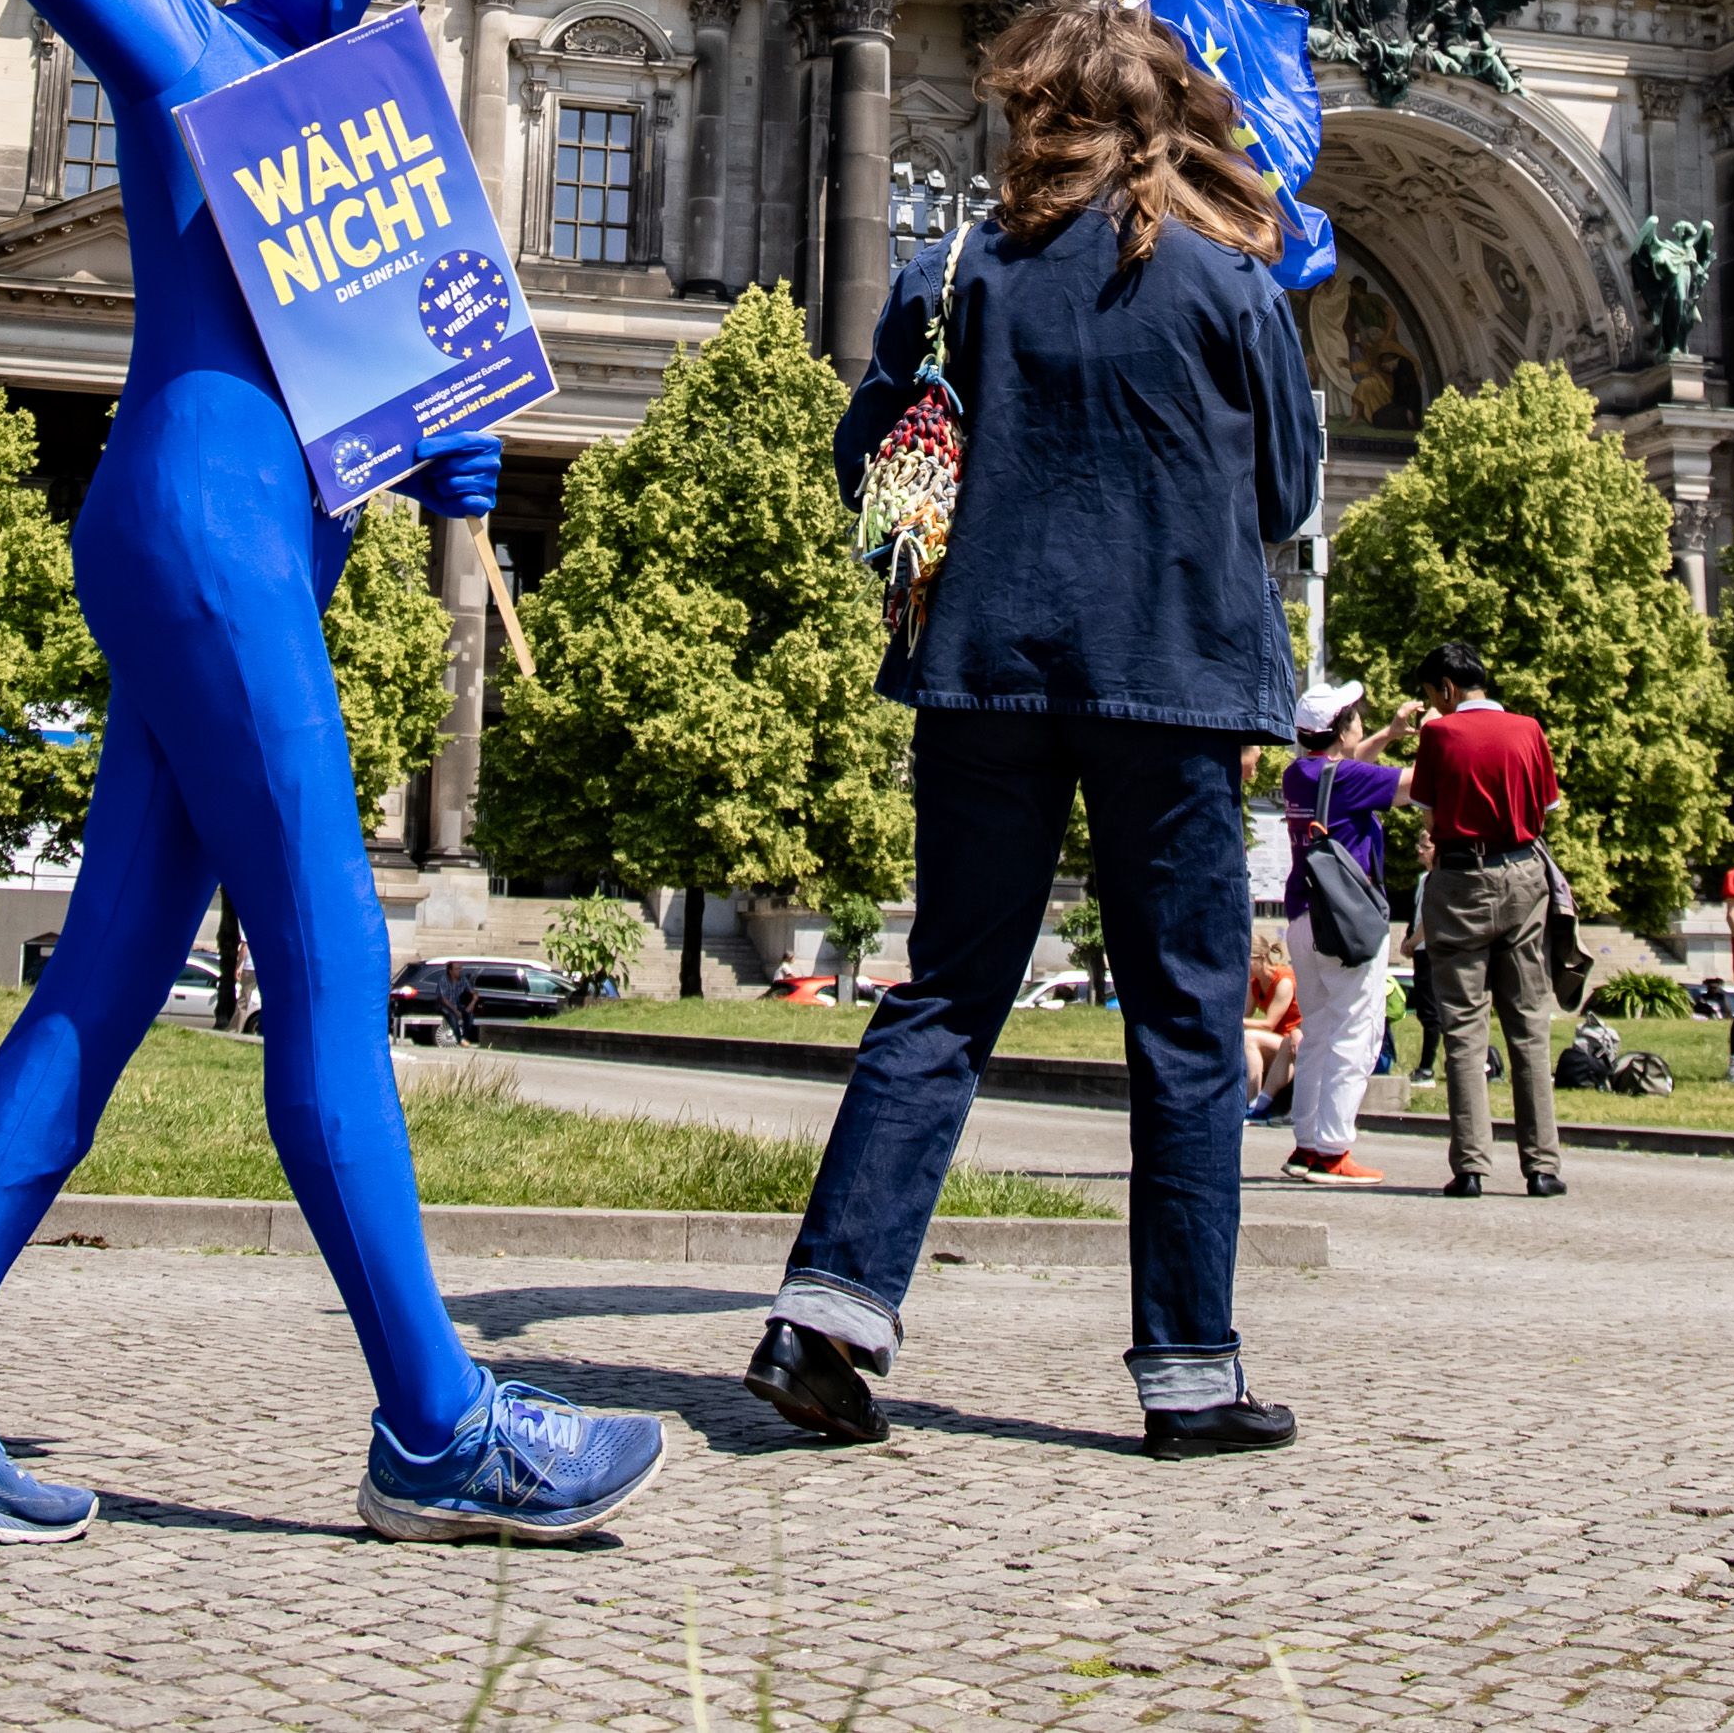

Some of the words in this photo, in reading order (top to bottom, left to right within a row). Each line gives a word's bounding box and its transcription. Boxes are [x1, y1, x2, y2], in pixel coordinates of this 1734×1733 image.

[232, 99, 434, 226] WÄHL
[258, 156, 452, 306] NICHT
[335, 279, 362, 303] DIE
[362, 250, 425, 290] EINFALT.
[433, 271, 480, 310] WÄHL
[443, 293, 498, 337] VIELFALT.
[453, 292, 475, 314] DIE
[448, 405, 468, 424] Juni
